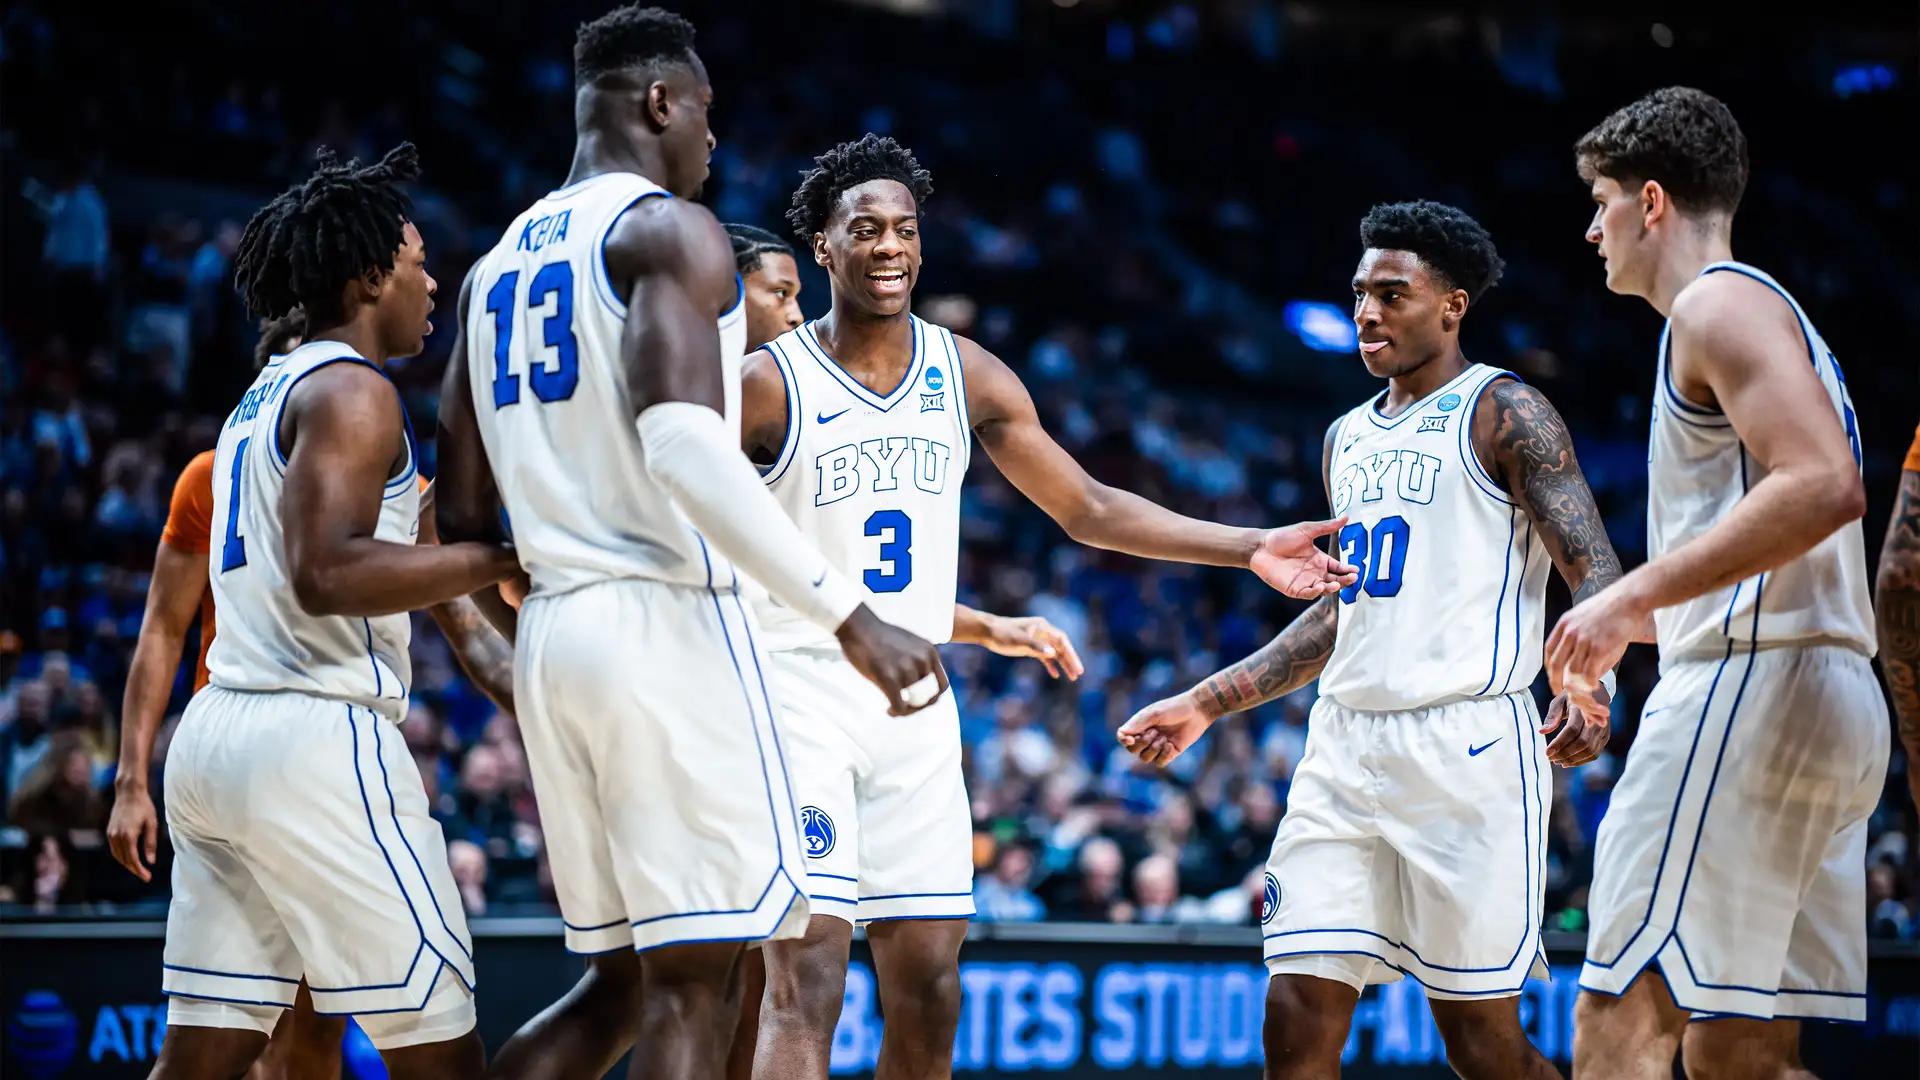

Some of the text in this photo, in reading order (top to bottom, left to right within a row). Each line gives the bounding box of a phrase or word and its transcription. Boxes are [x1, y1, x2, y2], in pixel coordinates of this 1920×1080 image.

[486, 260, 579, 410] 13
[221, 436, 250, 574] 1
[815, 436, 950, 507] BYU
[1333, 450, 1442, 518] BYU
[863, 509, 912, 593] 3
[1338, 515, 1411, 605] 30
[1093, 962, 1267, 1071] STUD
